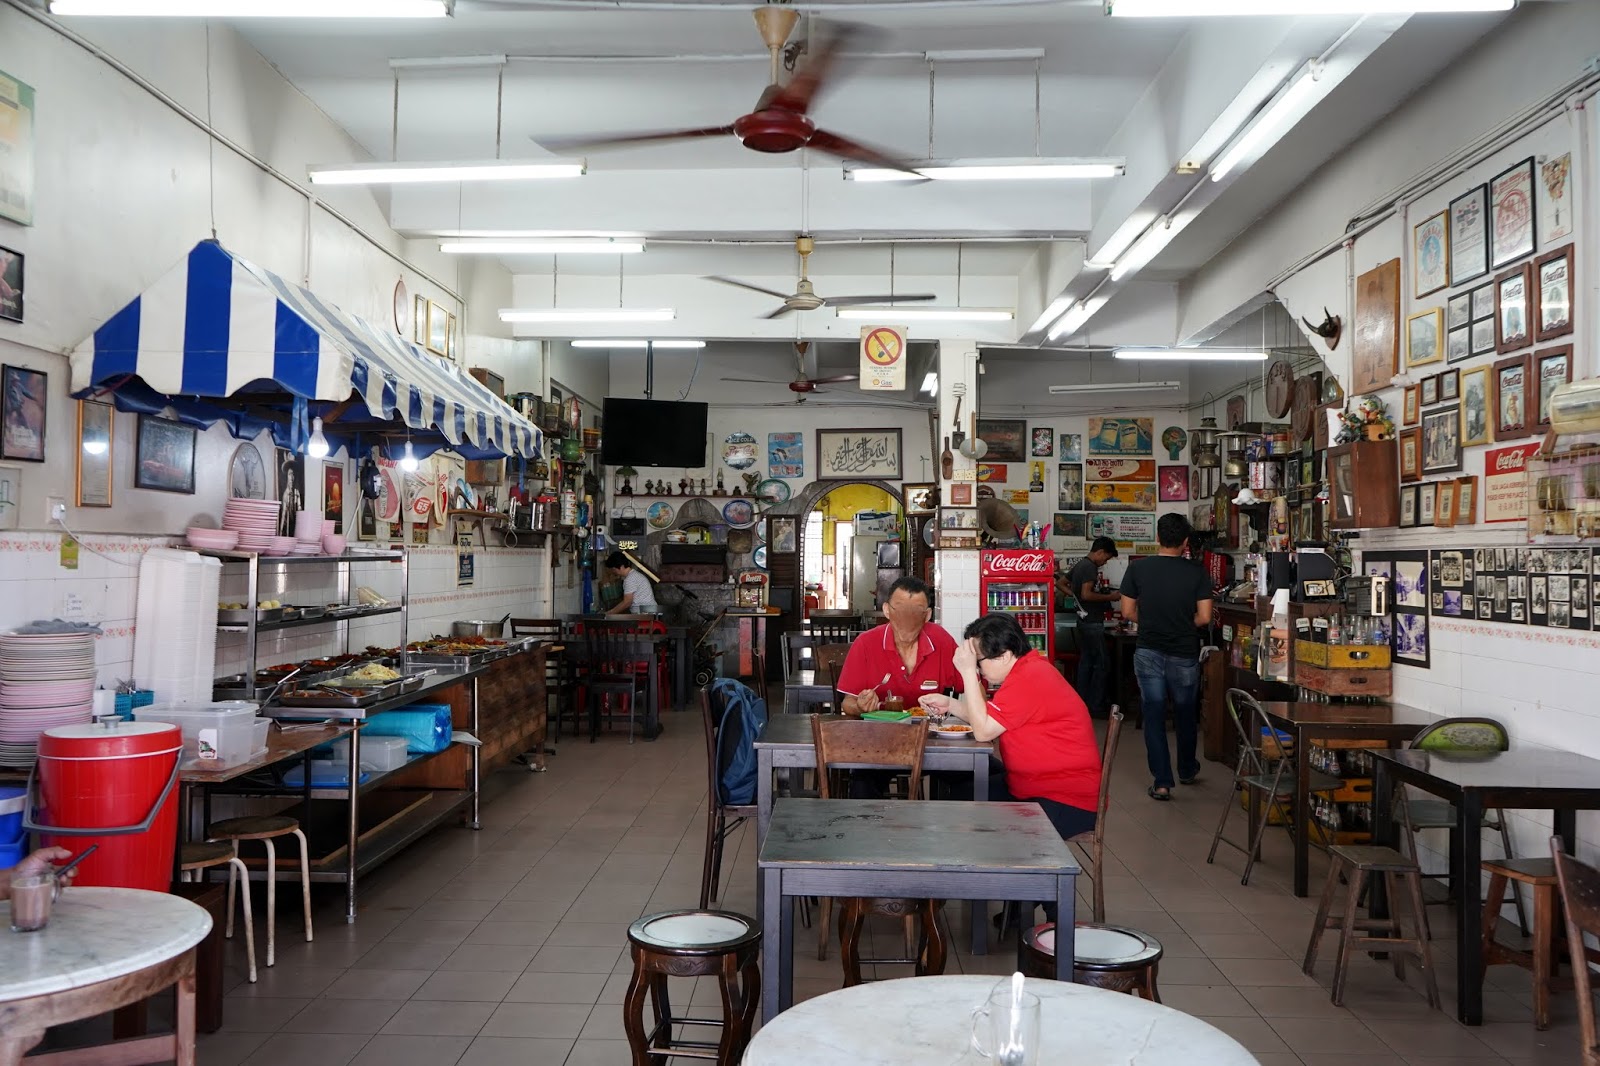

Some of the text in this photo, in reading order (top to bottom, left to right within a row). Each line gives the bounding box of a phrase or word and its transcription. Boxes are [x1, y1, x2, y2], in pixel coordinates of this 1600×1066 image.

[1502, 373, 1522, 388] Coca-Cola
[1496, 449, 1524, 470] Coca-Cola
[990, 553, 1045, 572] Coca-Cola
